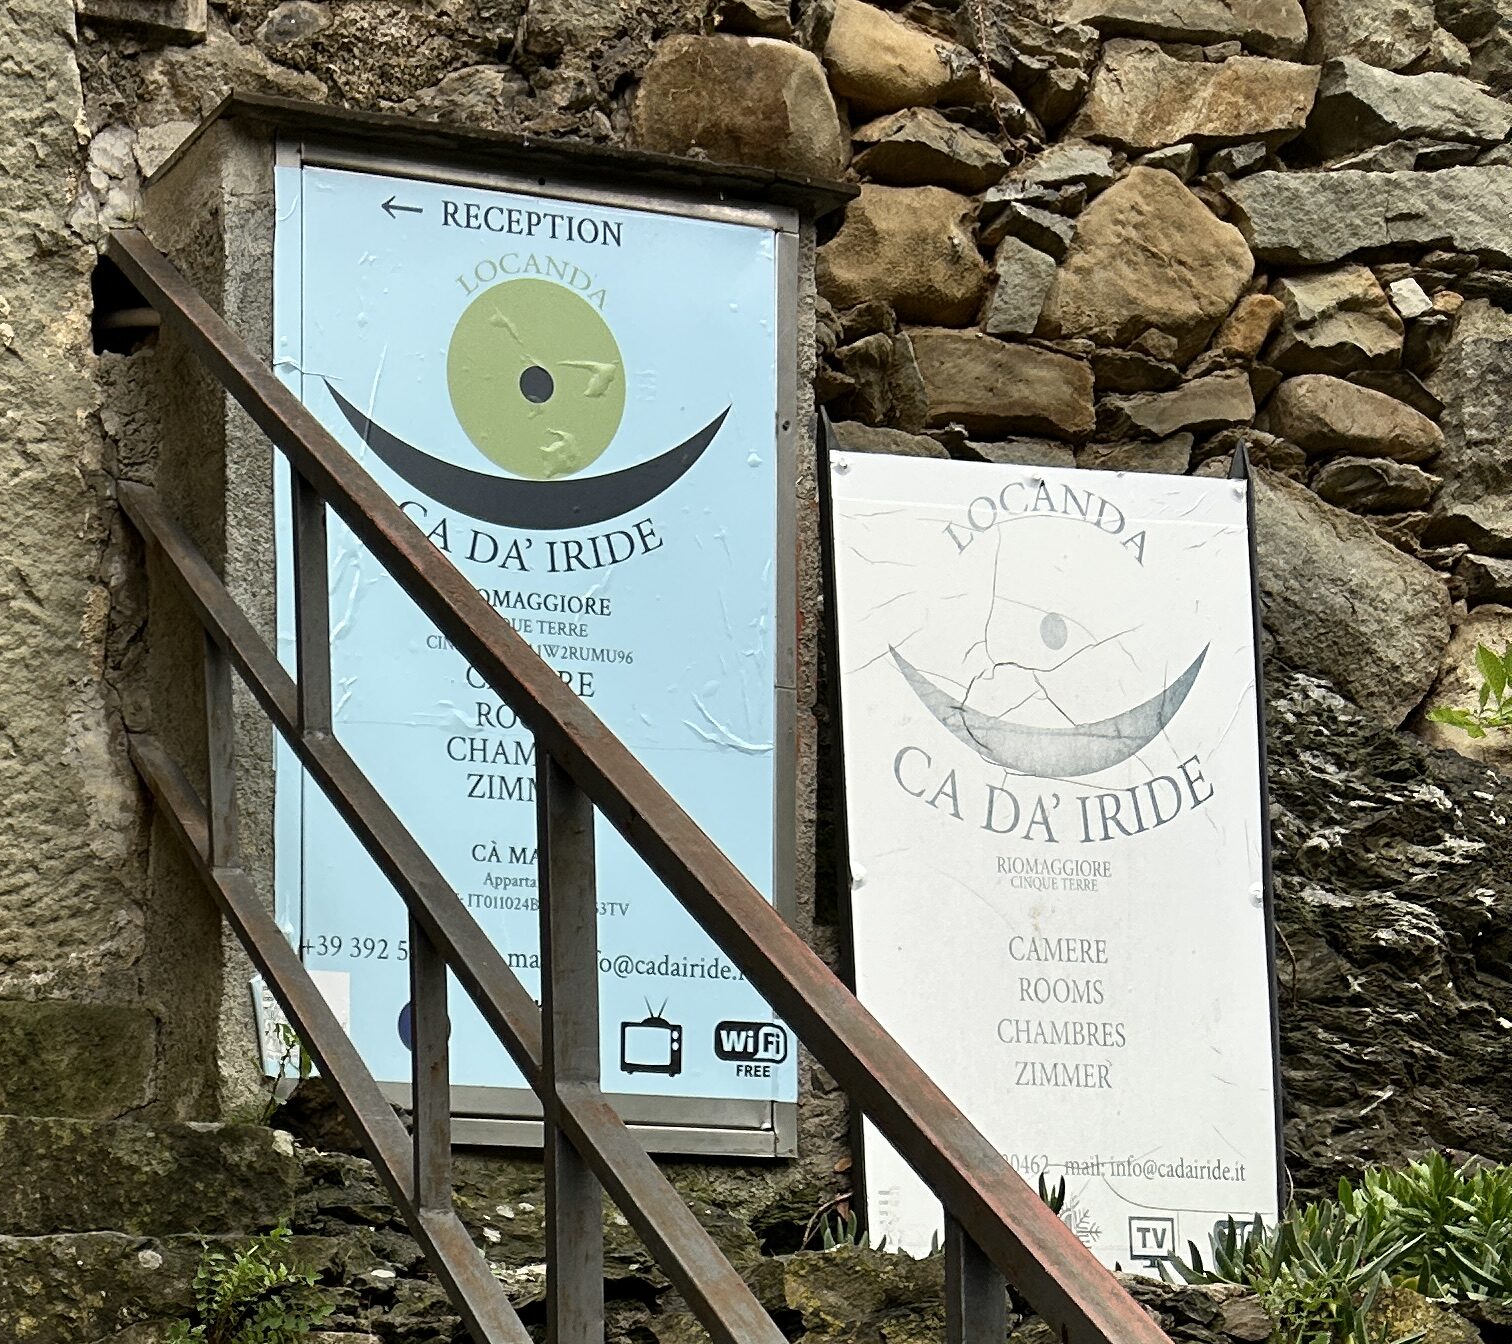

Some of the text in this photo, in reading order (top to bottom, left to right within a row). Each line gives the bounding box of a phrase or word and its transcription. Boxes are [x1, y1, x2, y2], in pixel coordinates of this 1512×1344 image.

[442, 200, 624, 247] RECEPTION
[456, 252, 608, 310] LOCANDA
[942, 480, 1150, 568] LOCANDA
[546, 518, 665, 573] IRIDE
[478, 589, 612, 617] OMAGGIORE
[536, 619, 589, 638] TERRE
[466, 666, 596, 699] CRE
[447, 736, 537, 767] CHAM
[893, 745, 965, 832] CA
[1078, 754, 1215, 844] IRIDE
[472, 840, 503, 864] CÀ
[996, 855, 1112, 878] RIOMAGGIORE
[483, 872, 538, 891] Apparta
[1010, 875, 1099, 892] CINQUE TERRE
[300, 934, 343, 957] +39
[349, 936, 389, 960] 392
[1008, 935, 1109, 965] CAMERE
[1019, 976, 1105, 1004] ROOMS
[997, 1018, 1127, 1048] CHAMBRES
[736, 1064, 771, 1079] FREE
[1015, 1061, 1113, 1089] ZIMMER
[1110, 1154, 1245, 1182] info@cadairide.it
[1136, 1226, 1168, 1250] TV
